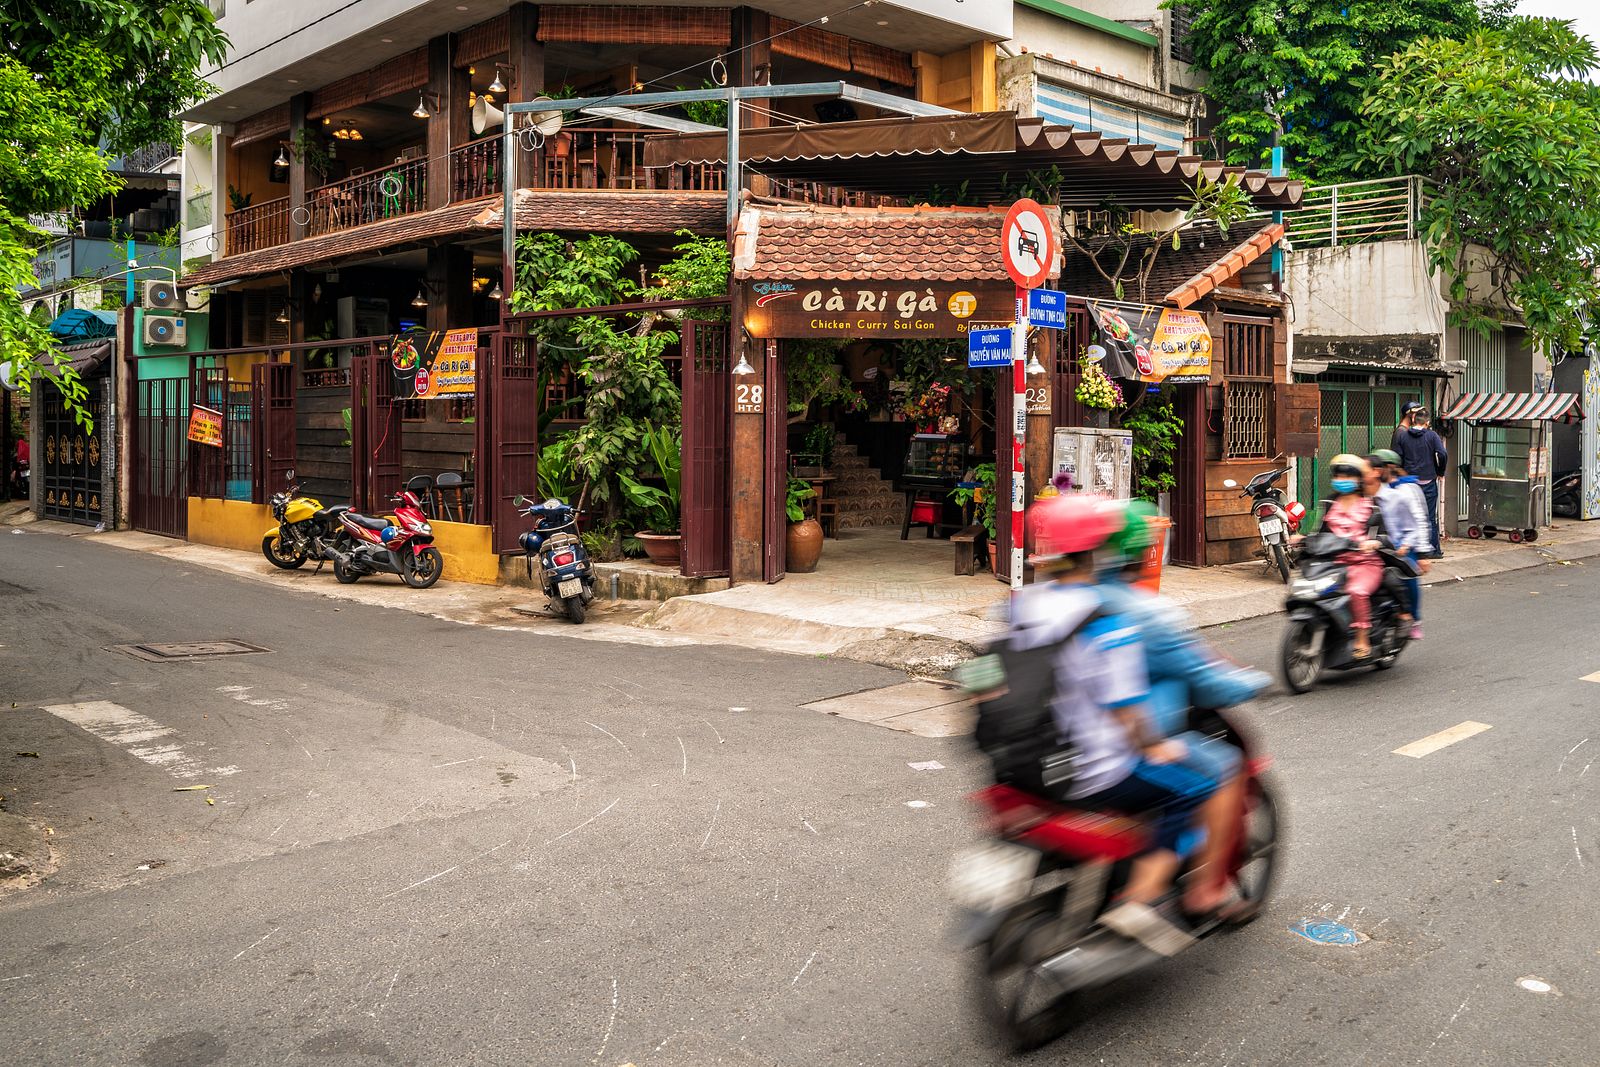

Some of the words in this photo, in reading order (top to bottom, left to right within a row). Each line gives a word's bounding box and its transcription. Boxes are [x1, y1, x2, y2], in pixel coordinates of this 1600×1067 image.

[802, 288, 845, 312] Cà
[856, 290, 888, 312] Ri
[896, 288, 938, 319] Gà
[810, 320, 851, 330] Chicken
[857, 320, 888, 330] Curry
[894, 320, 913, 330] Sai
[915, 320, 935, 330] Gon
[956, 324, 968, 332] By
[736, 384, 762, 404] 28
[1026, 388, 1047, 403] 28
